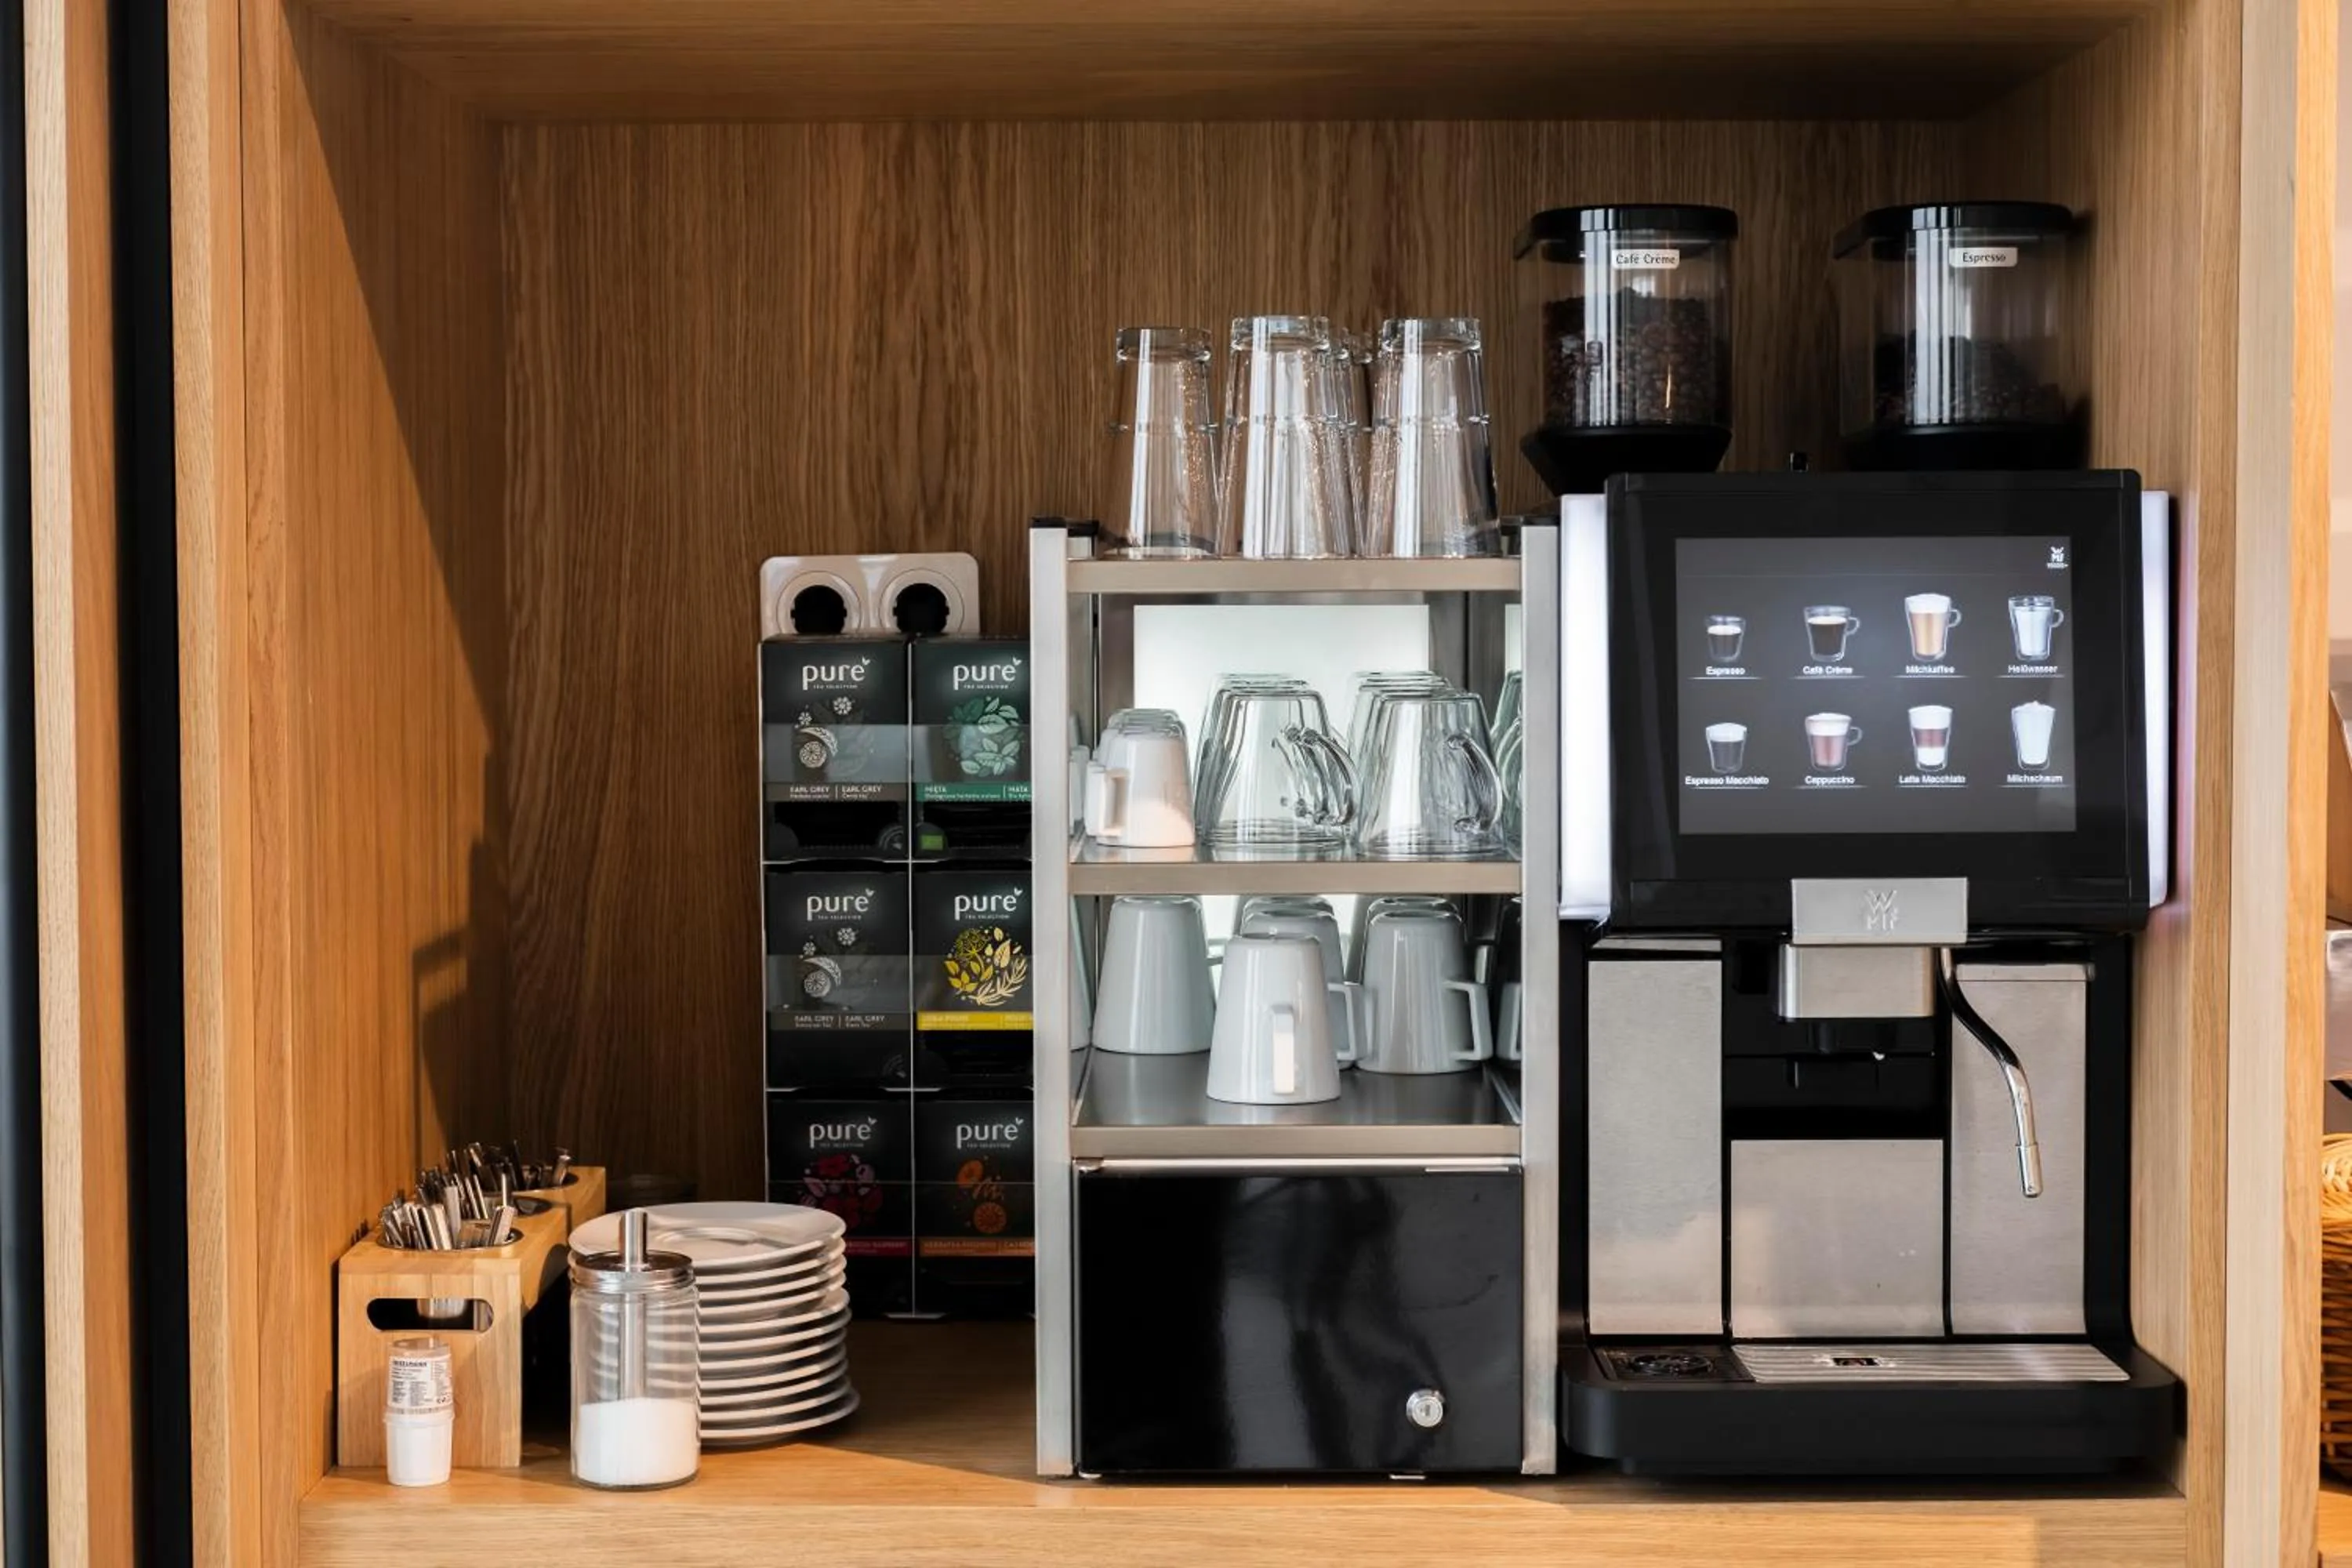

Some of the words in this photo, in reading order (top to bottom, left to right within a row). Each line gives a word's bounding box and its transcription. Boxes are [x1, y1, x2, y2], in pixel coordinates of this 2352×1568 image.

[1962, 252, 2006, 263] Espresso
[802, 664, 866, 691] pure
[953, 664, 1017, 691] pure
[1705, 666, 1746, 676] Espresso
[1685, 775, 1725, 786] Espresso
[1805, 775, 1856, 786] Cappuccino
[806, 895, 869, 921] pure
[954, 895, 1017, 921] pure
[809, 1123, 872, 1149] pure
[956, 1123, 1018, 1149] pure
